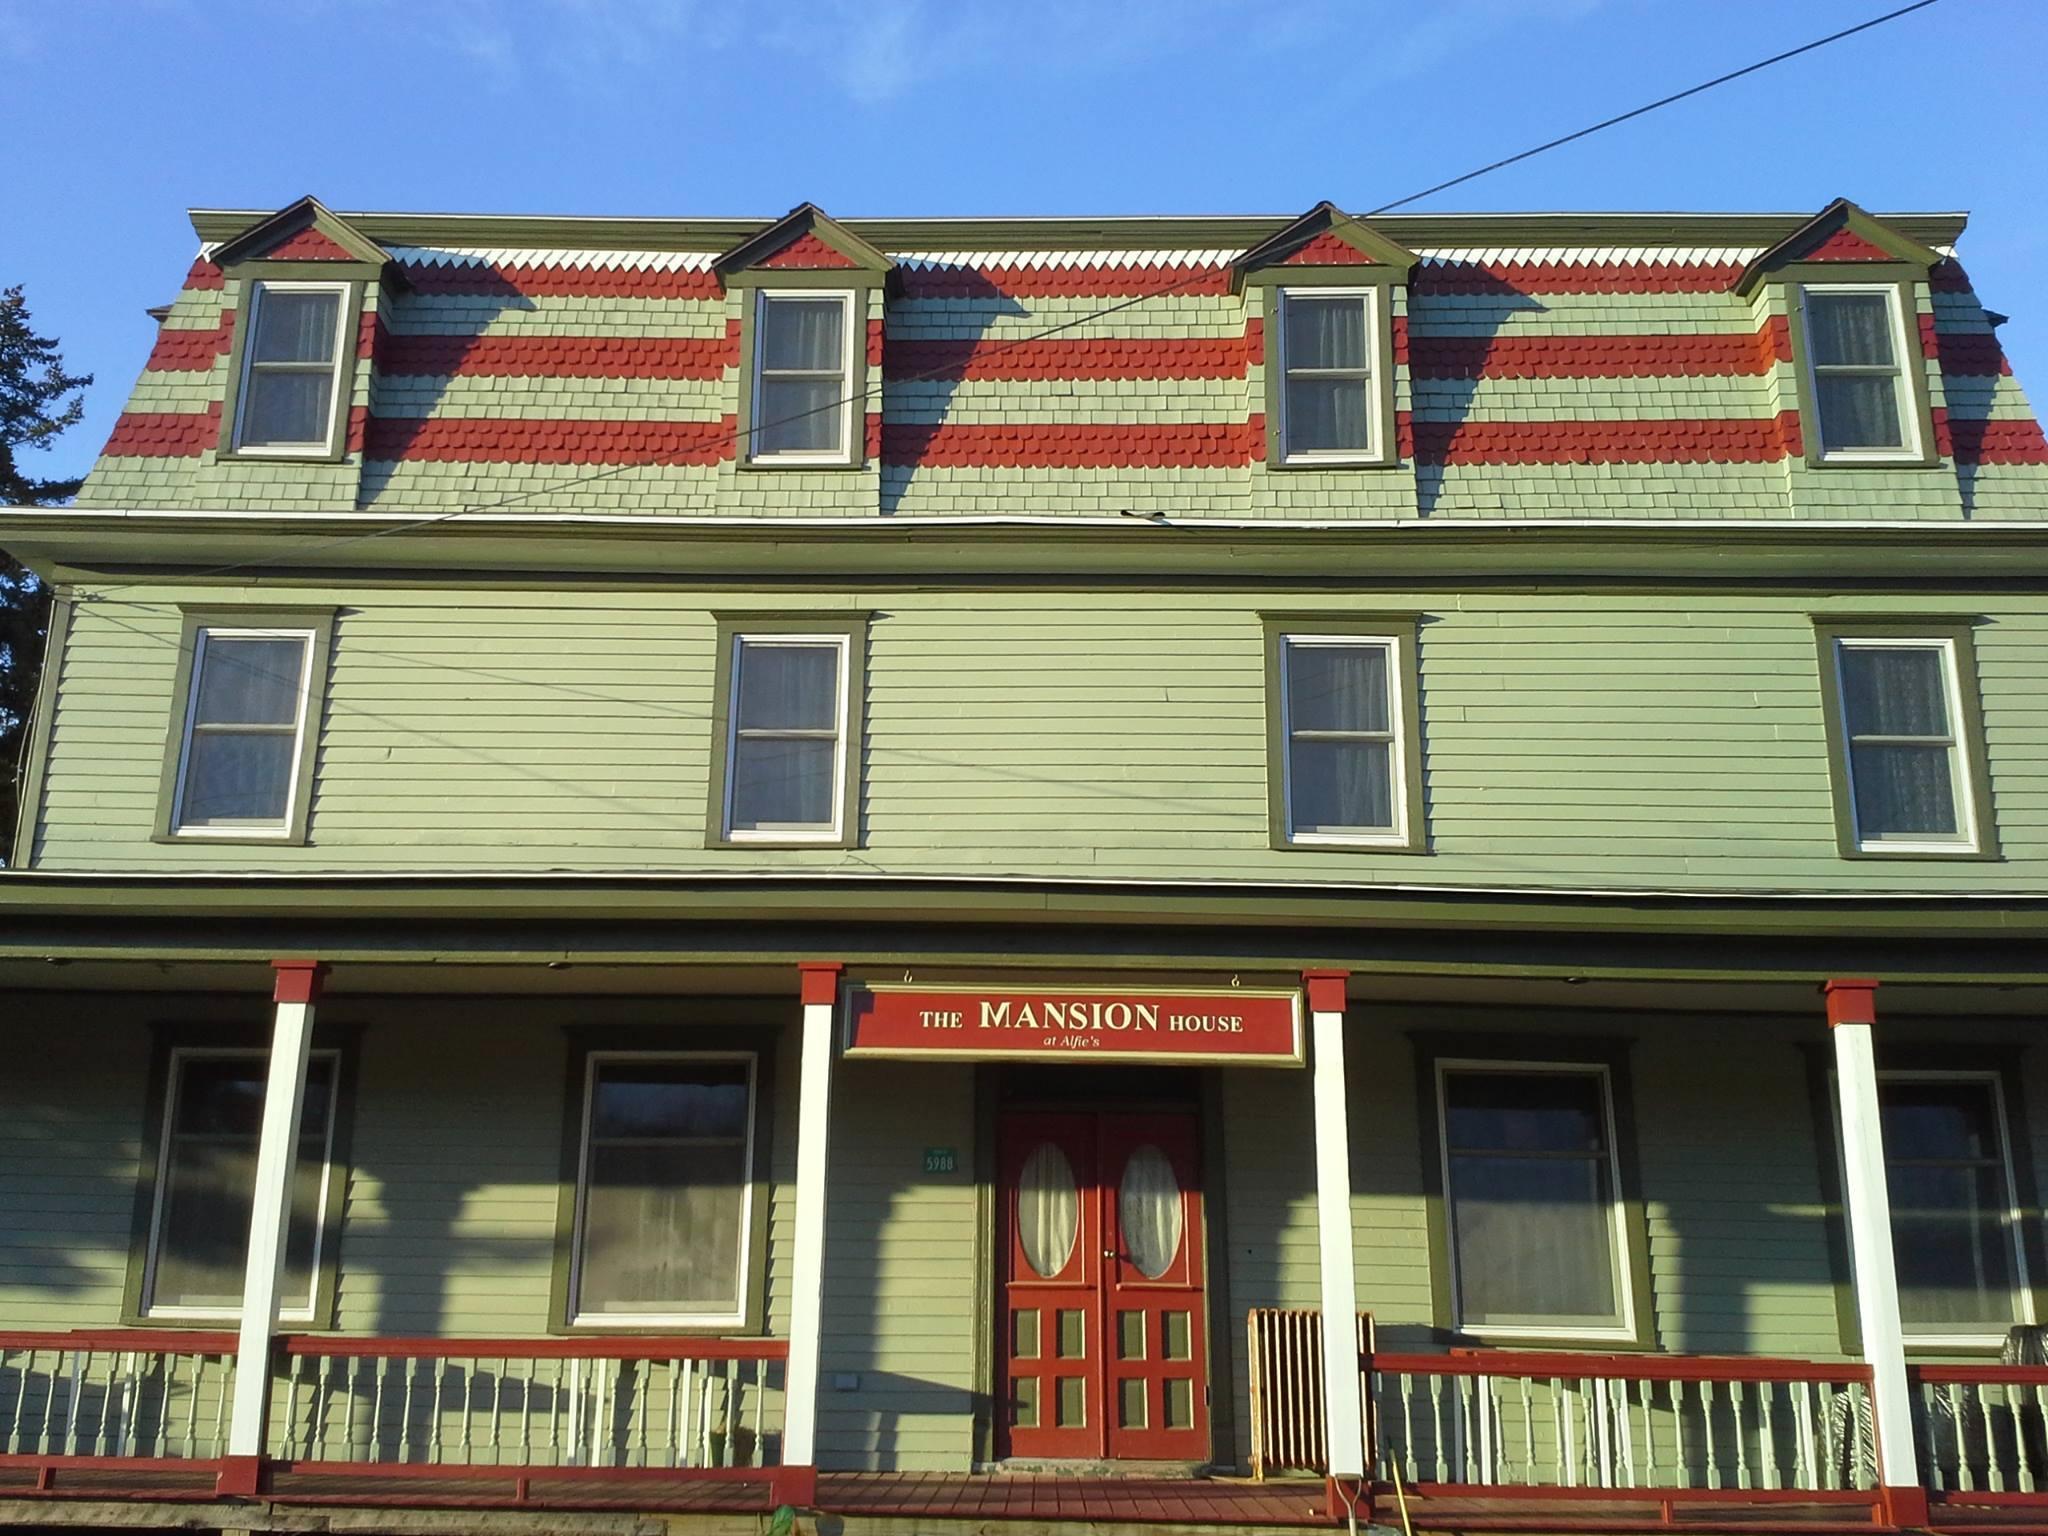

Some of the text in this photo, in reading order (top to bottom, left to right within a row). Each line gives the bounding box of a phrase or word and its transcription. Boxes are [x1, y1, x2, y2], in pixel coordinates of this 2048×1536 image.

[919, 1001, 1244, 1033] THE MANSION HOUSE
[1043, 1035, 1100, 1049] at Alfie's
